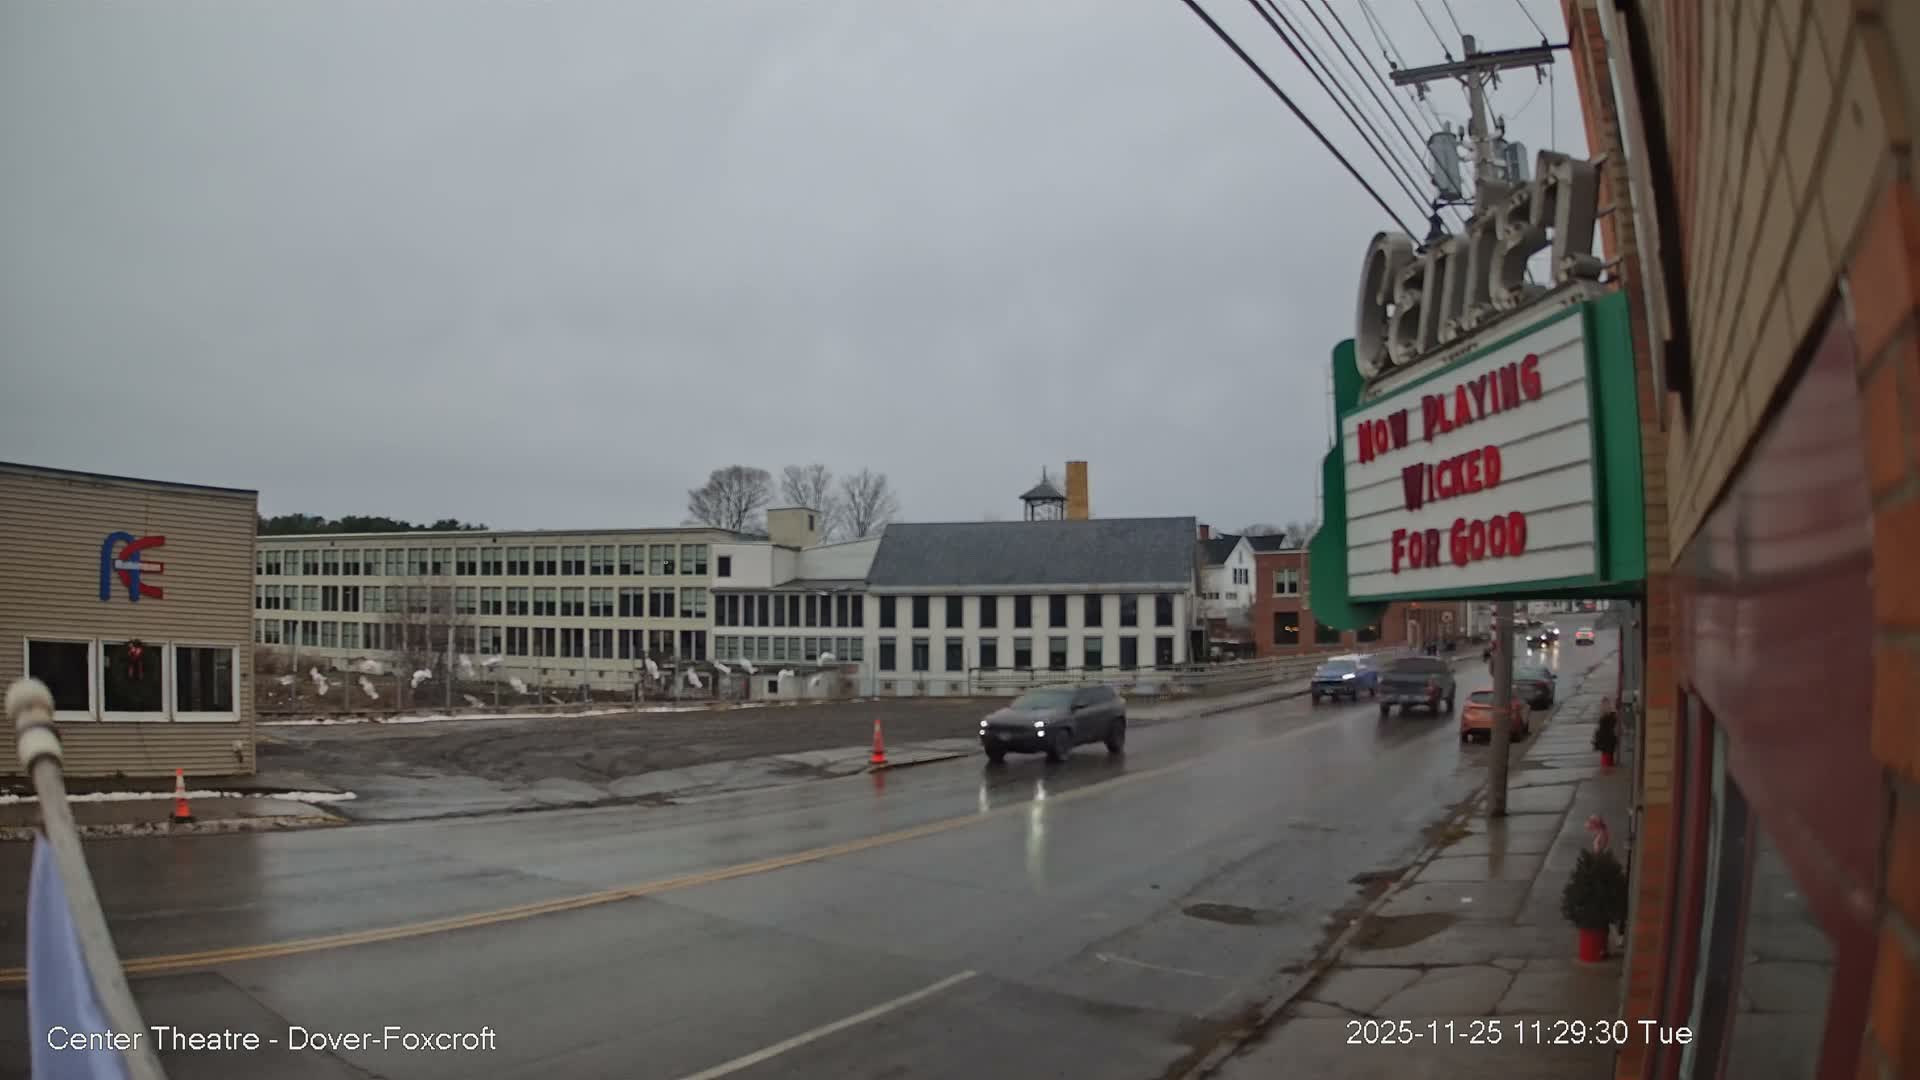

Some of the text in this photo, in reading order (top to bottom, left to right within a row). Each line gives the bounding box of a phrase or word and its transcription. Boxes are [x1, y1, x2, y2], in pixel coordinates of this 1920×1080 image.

[1357, 353, 1542, 464] NOW PLAYING
[1402, 444, 1502, 512] WICKED
[1391, 511, 1527, 575] FOR GOOD
